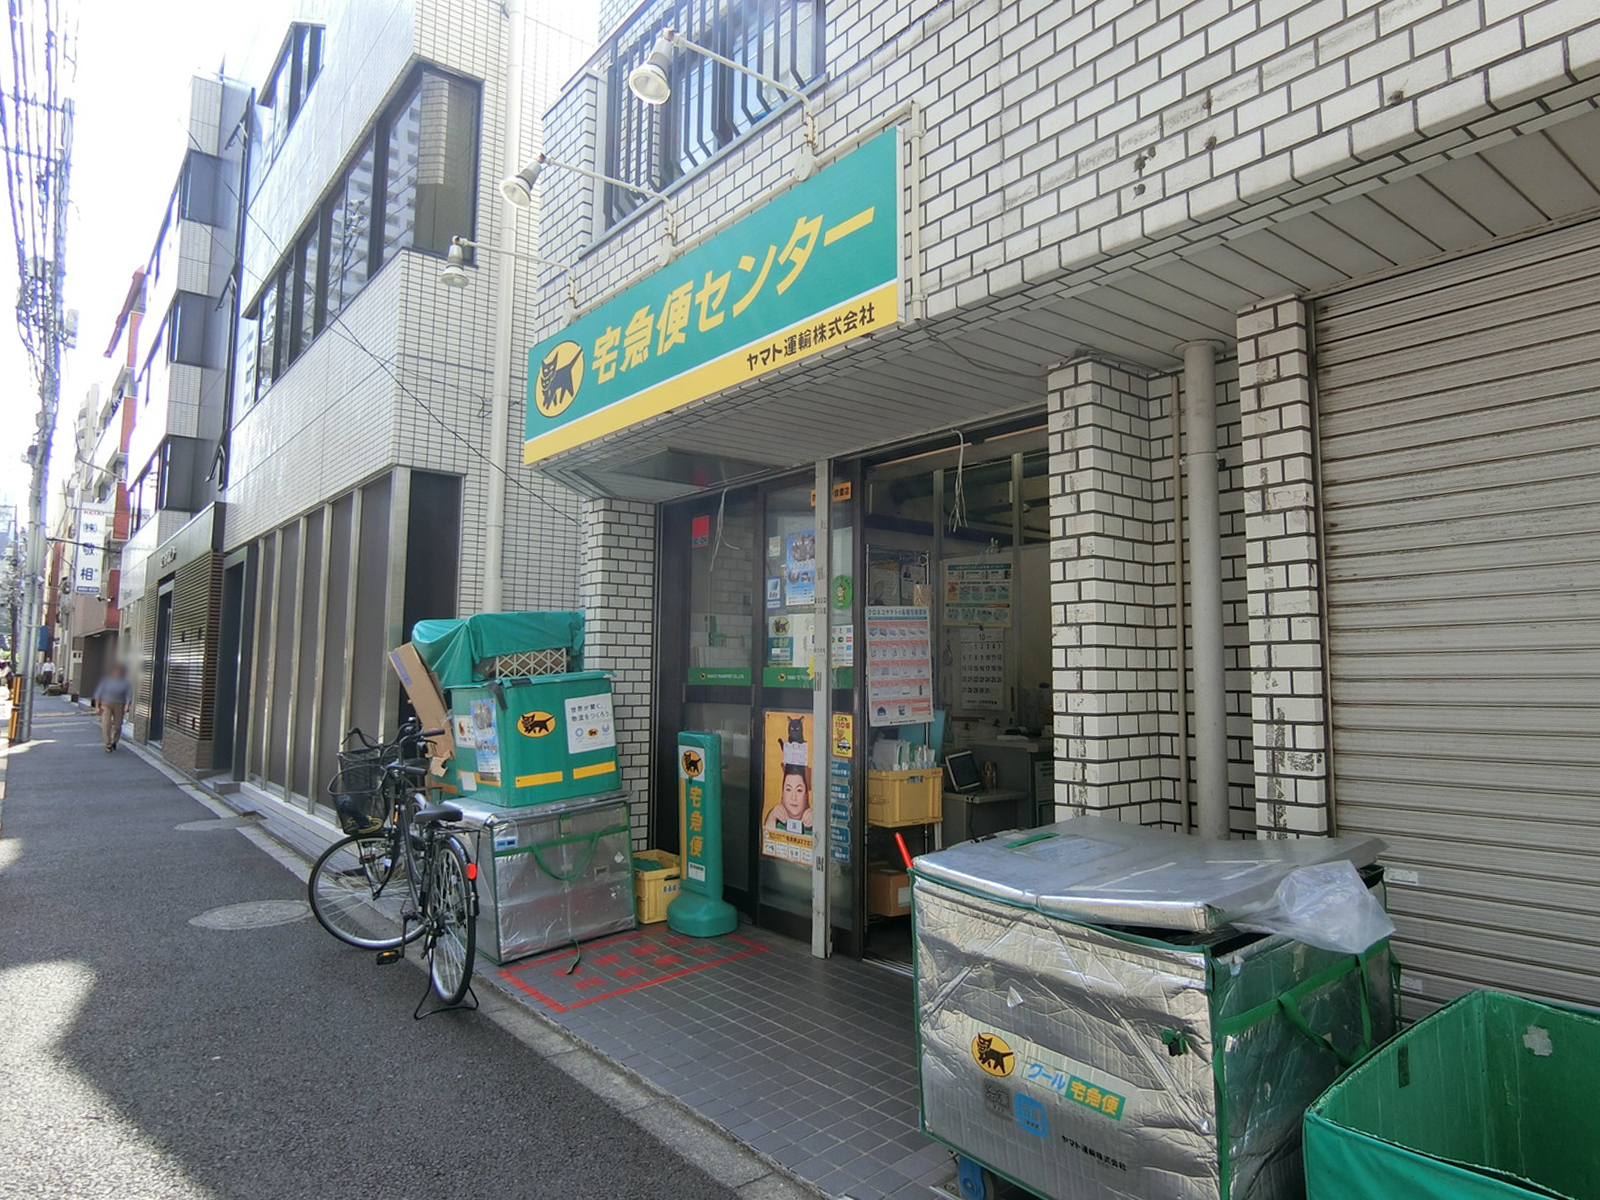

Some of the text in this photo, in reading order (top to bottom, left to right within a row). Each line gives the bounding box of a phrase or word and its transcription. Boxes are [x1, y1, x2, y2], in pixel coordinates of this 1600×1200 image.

[591, 206, 875, 384] 宅急便センター
[746, 302, 875, 371] ヤマト運輸株式会社
[690, 786, 703, 858] 宅急便
[1061, 1134, 1127, 1172] ヤマト運輸株式会社
